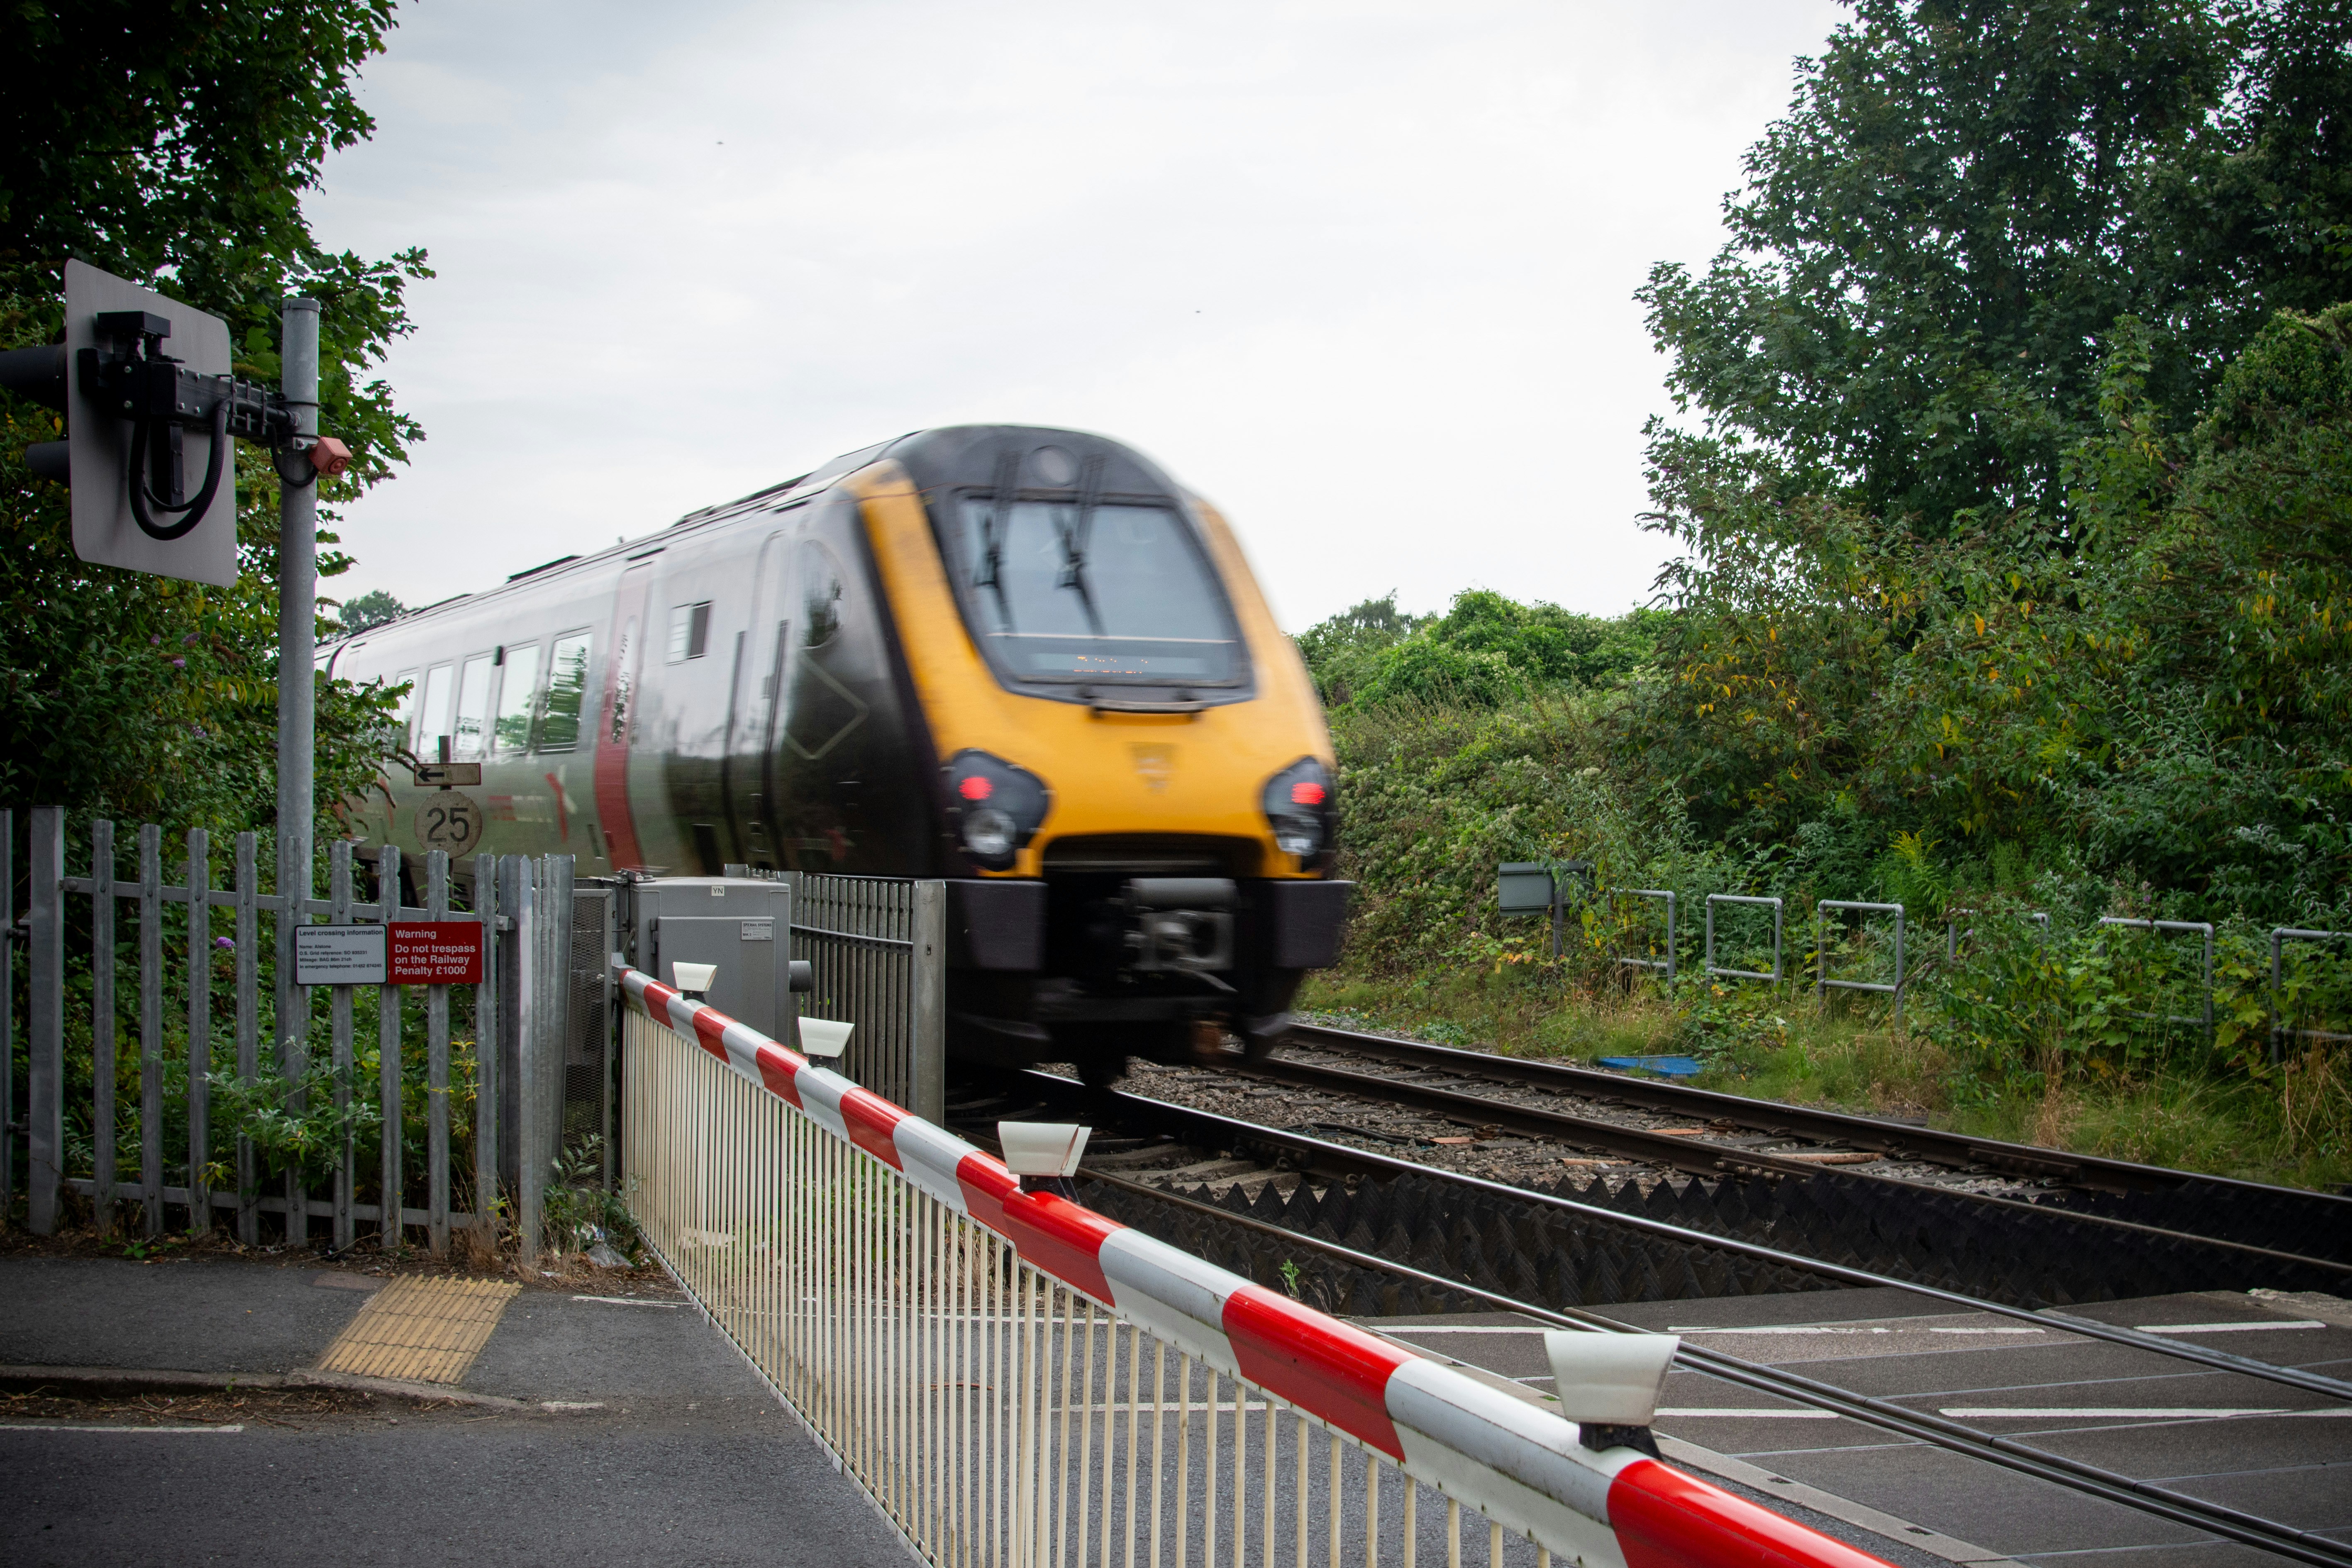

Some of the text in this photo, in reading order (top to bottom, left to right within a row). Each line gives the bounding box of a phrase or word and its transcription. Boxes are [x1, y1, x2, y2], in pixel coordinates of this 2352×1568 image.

[427, 807, 469, 842] 25
[395, 929, 437, 939] Warning
[395, 944, 476, 955] Do not trespass
[411, 955, 427, 964] the
[430, 955, 470, 966] Railway
[395, 966, 466, 977] Penalty £1000
